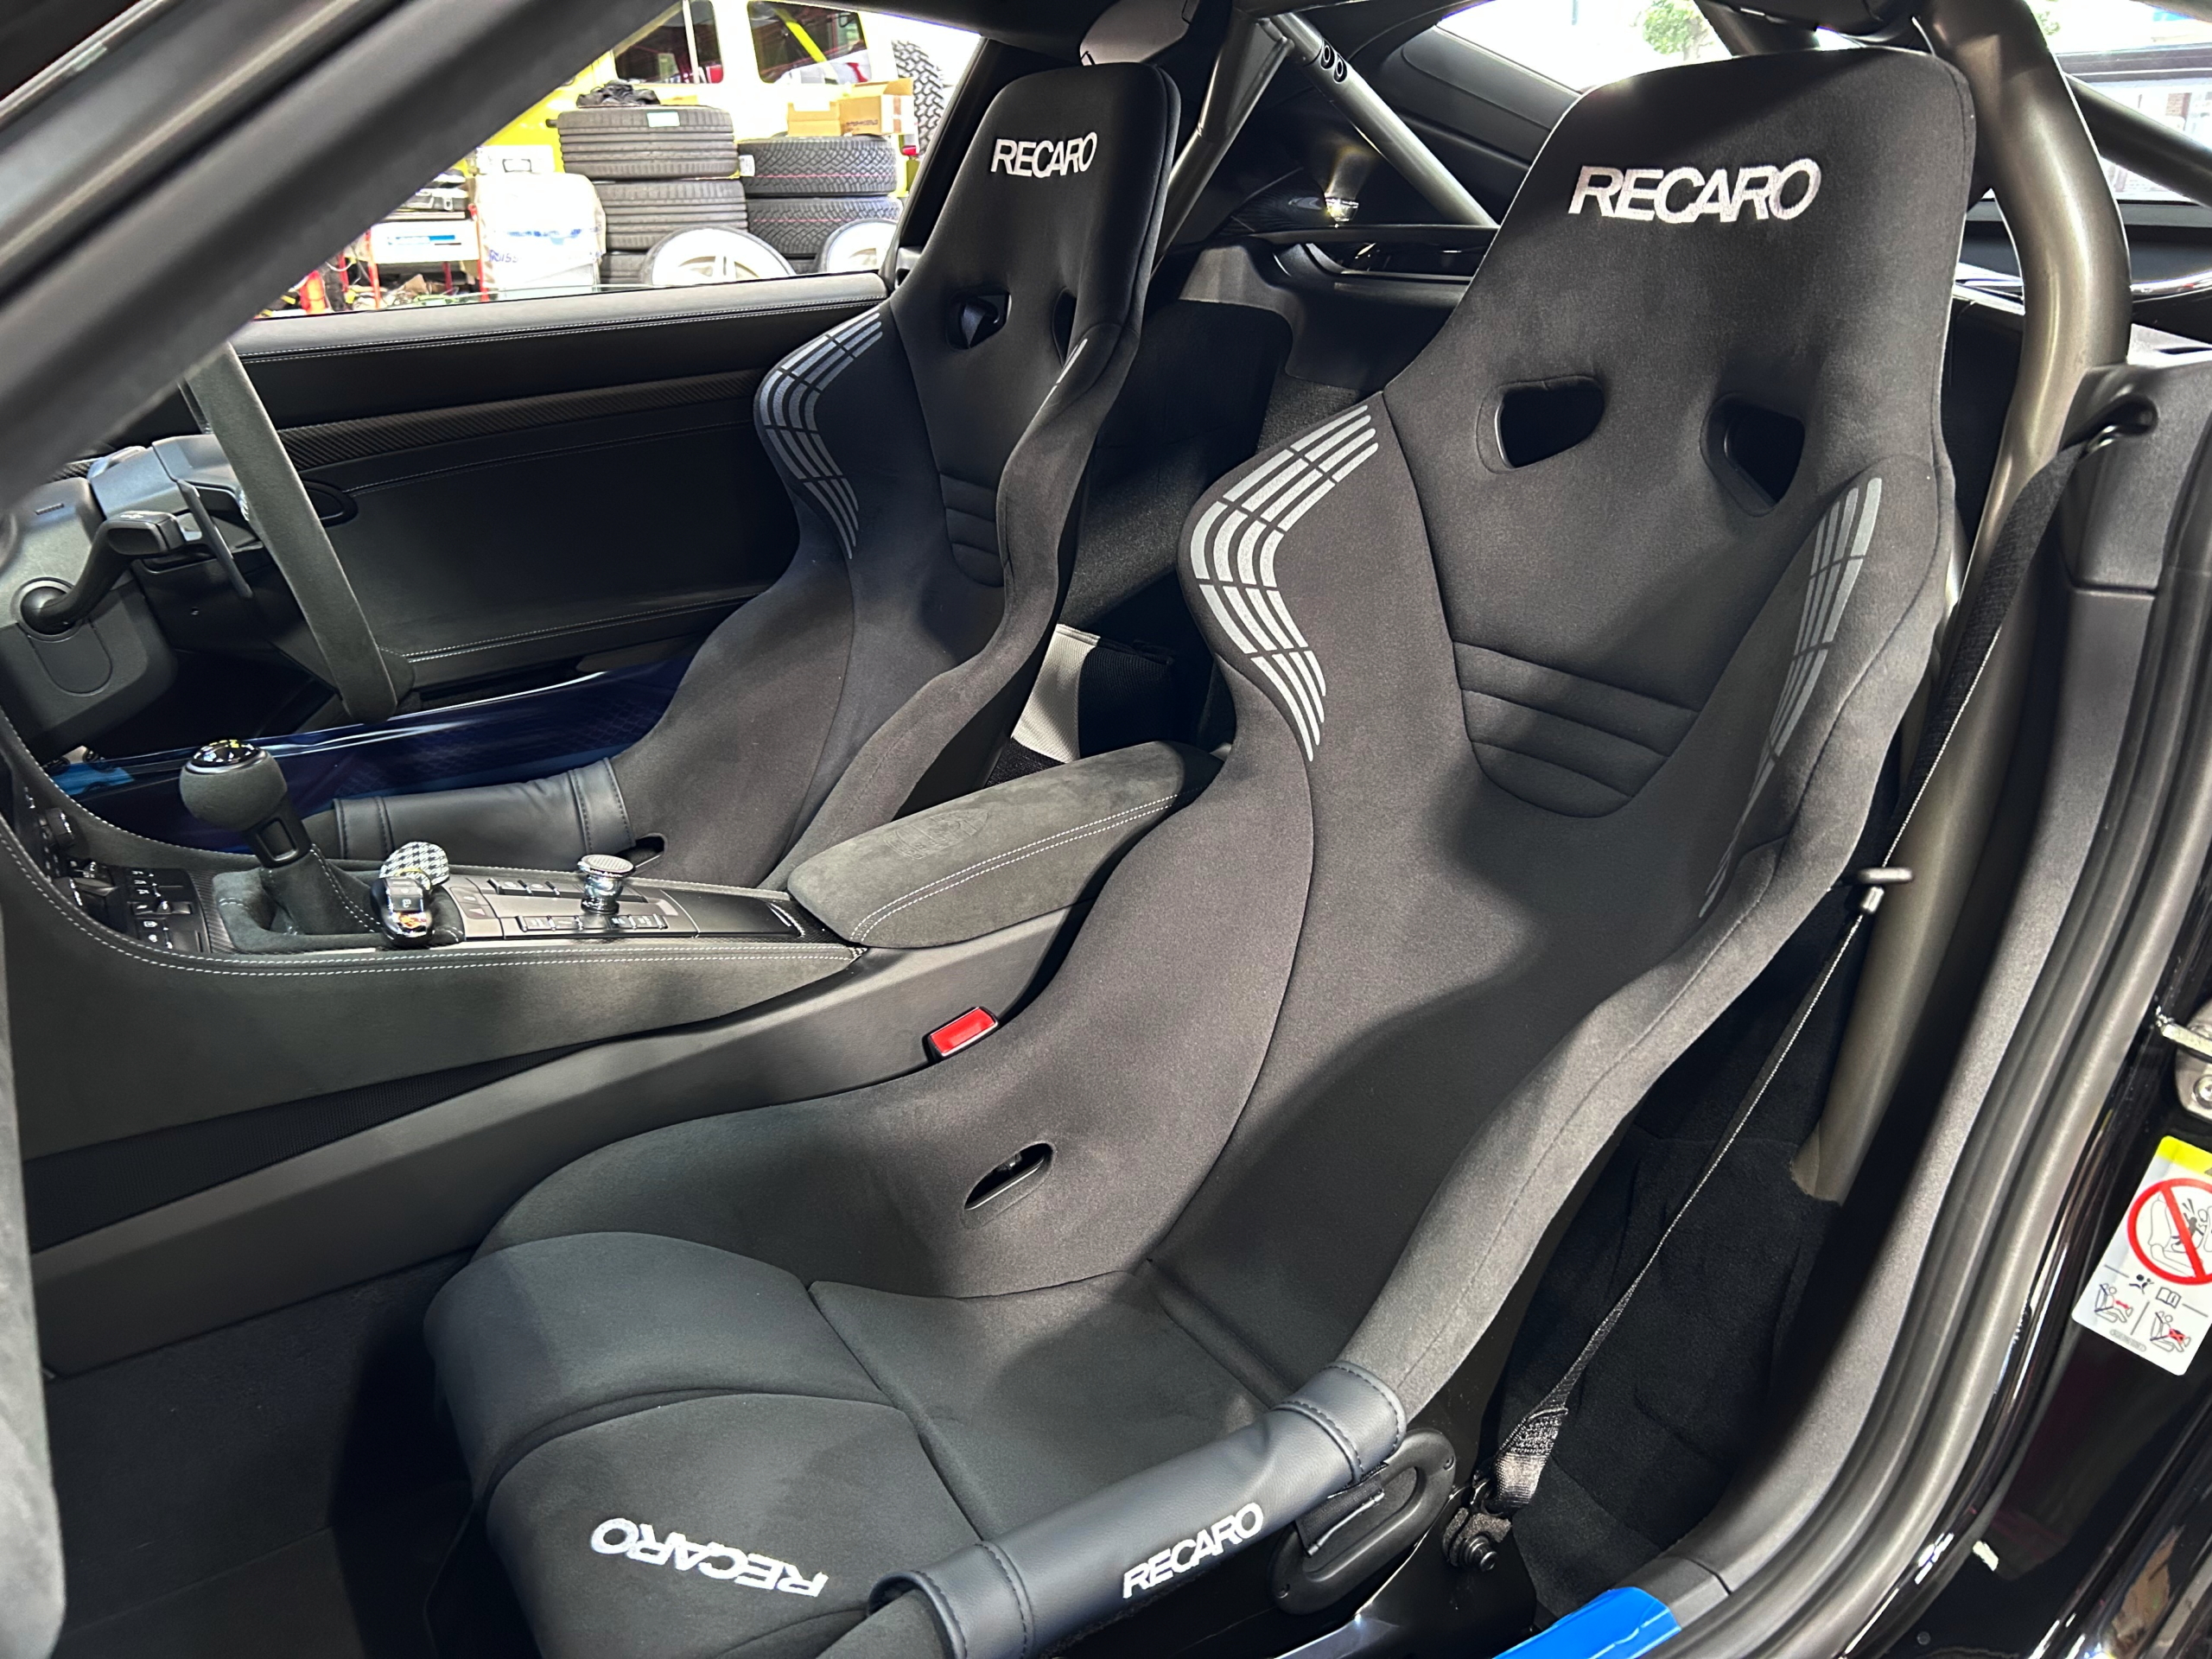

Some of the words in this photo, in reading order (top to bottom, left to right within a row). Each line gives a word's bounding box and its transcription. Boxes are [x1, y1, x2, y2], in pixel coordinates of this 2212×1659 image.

[990, 131, 1098, 179] RECARO
[1567, 158, 1821, 224] RECARO
[590, 1517, 830, 1598] RECARO
[1122, 1502, 1264, 1599] RECARO
